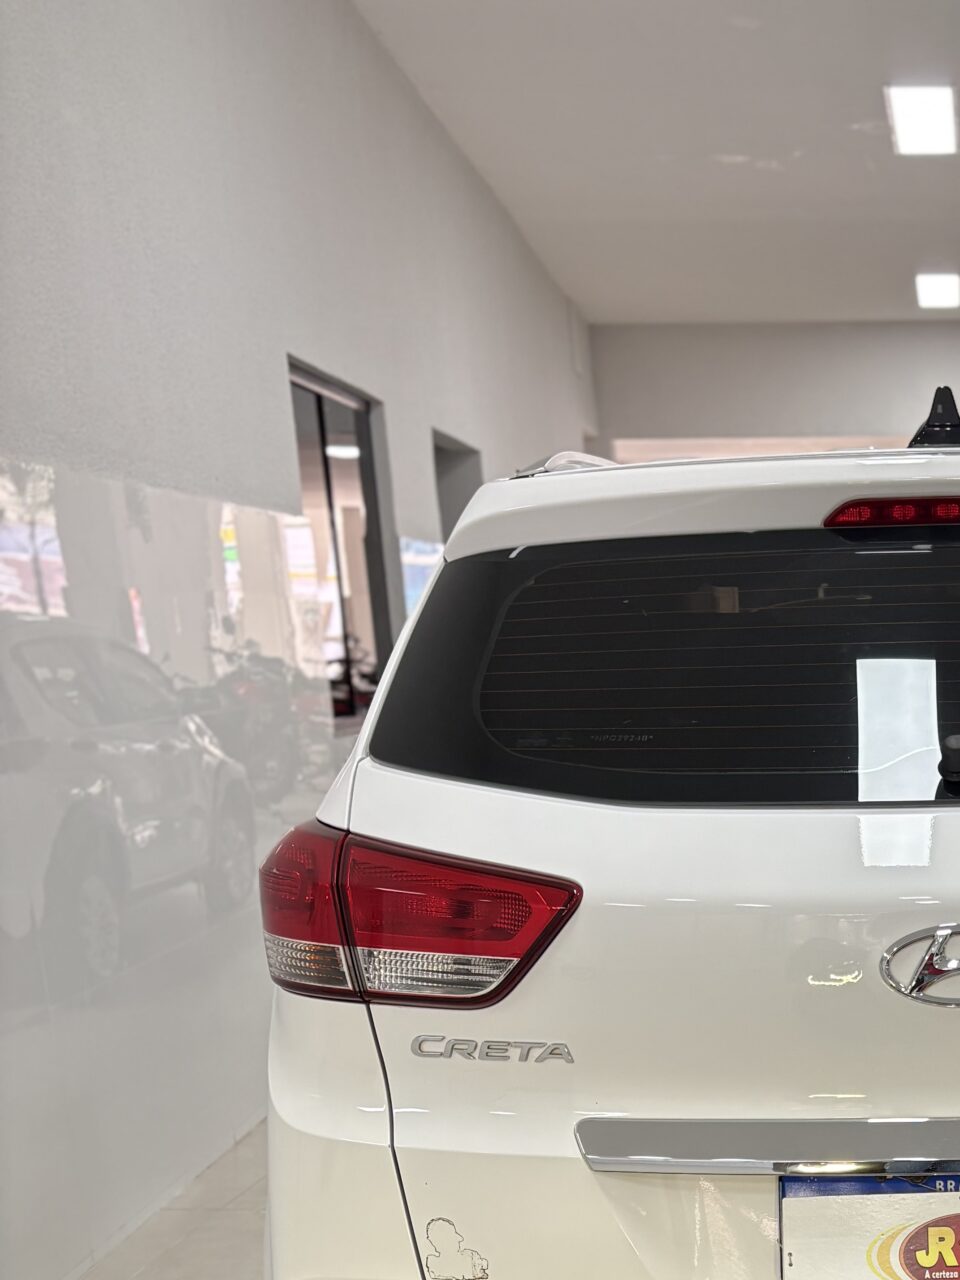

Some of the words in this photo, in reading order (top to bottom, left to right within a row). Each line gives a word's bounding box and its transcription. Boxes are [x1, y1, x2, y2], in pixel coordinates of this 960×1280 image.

[410, 1034, 575, 1064] CRETA
[915, 1226, 960, 1268] JR
[924, 1269, 931, 1279] A
[932, 1269, 959, 1279] certeza
